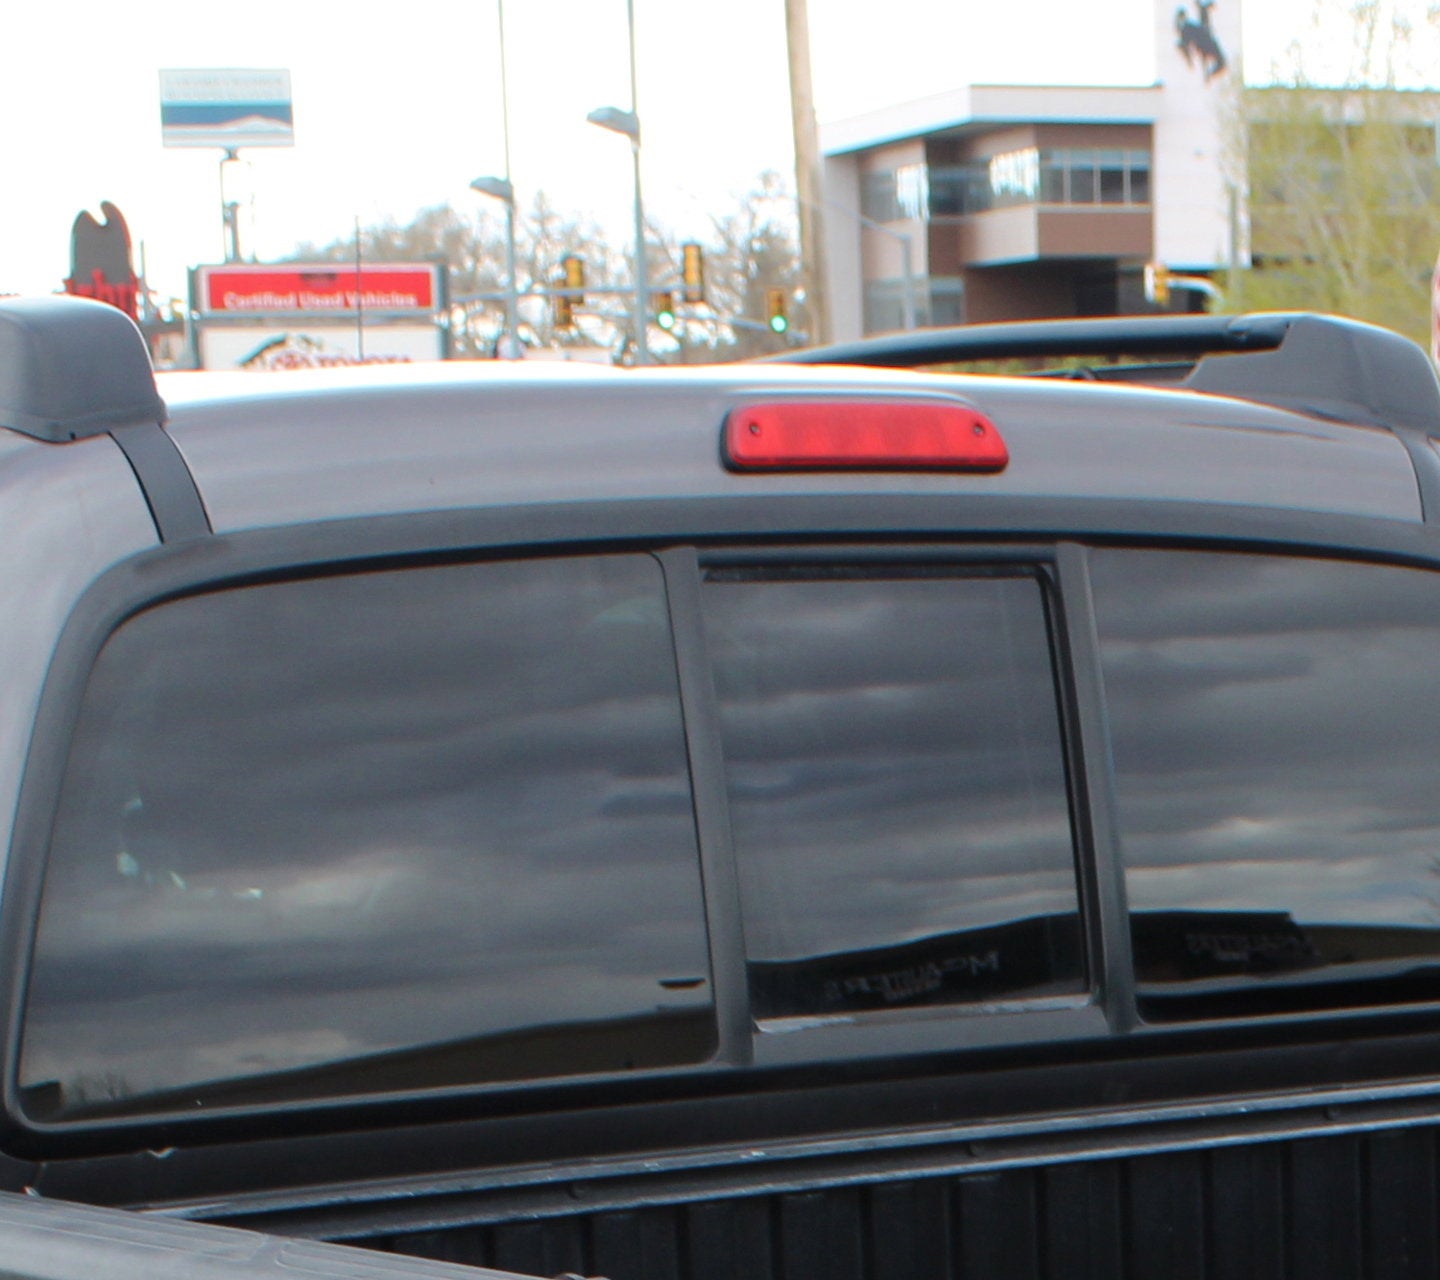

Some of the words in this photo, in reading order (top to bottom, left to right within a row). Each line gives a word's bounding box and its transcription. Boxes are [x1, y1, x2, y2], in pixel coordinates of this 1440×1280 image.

[223, 291, 297, 311] Certified
[299, 291, 345, 311] Used
[346, 291, 419, 311] Vehicles
